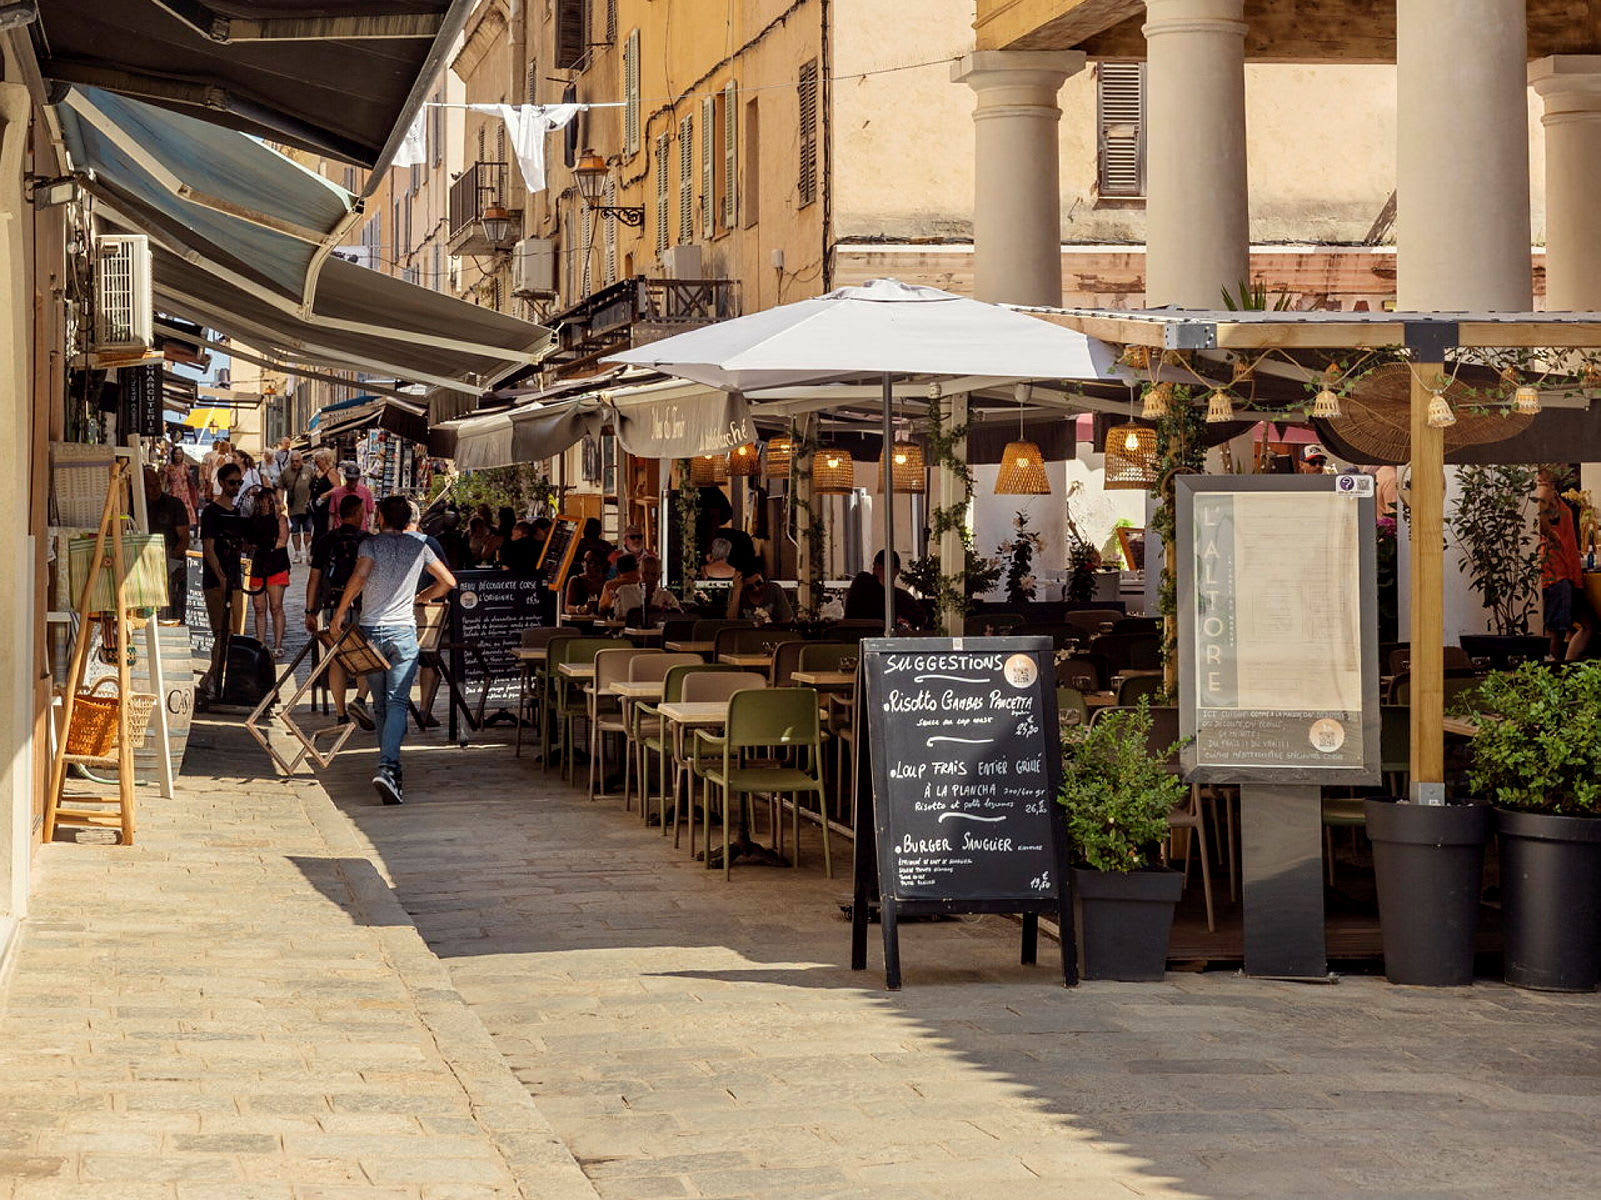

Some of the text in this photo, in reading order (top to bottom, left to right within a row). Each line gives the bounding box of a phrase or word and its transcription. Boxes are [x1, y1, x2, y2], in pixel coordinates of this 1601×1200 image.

[146, 364, 155, 433] CHARCUTERIE
[1202, 506, 1223, 692] L'ALTORE
[884, 653, 1003, 674] SUGGESTIONS
[889, 689, 937, 713] Risotto
[941, 689, 984, 711] GAMBAS
[932, 760, 968, 776] FRAIS
[978, 758, 1008, 775] ENTIER
[924, 782, 931, 798] À
[936, 784, 948, 797] LA
[951, 784, 997, 797] PLANCHA
[914, 800, 947, 812] Risotto
[903, 833, 953, 853] BURGER
